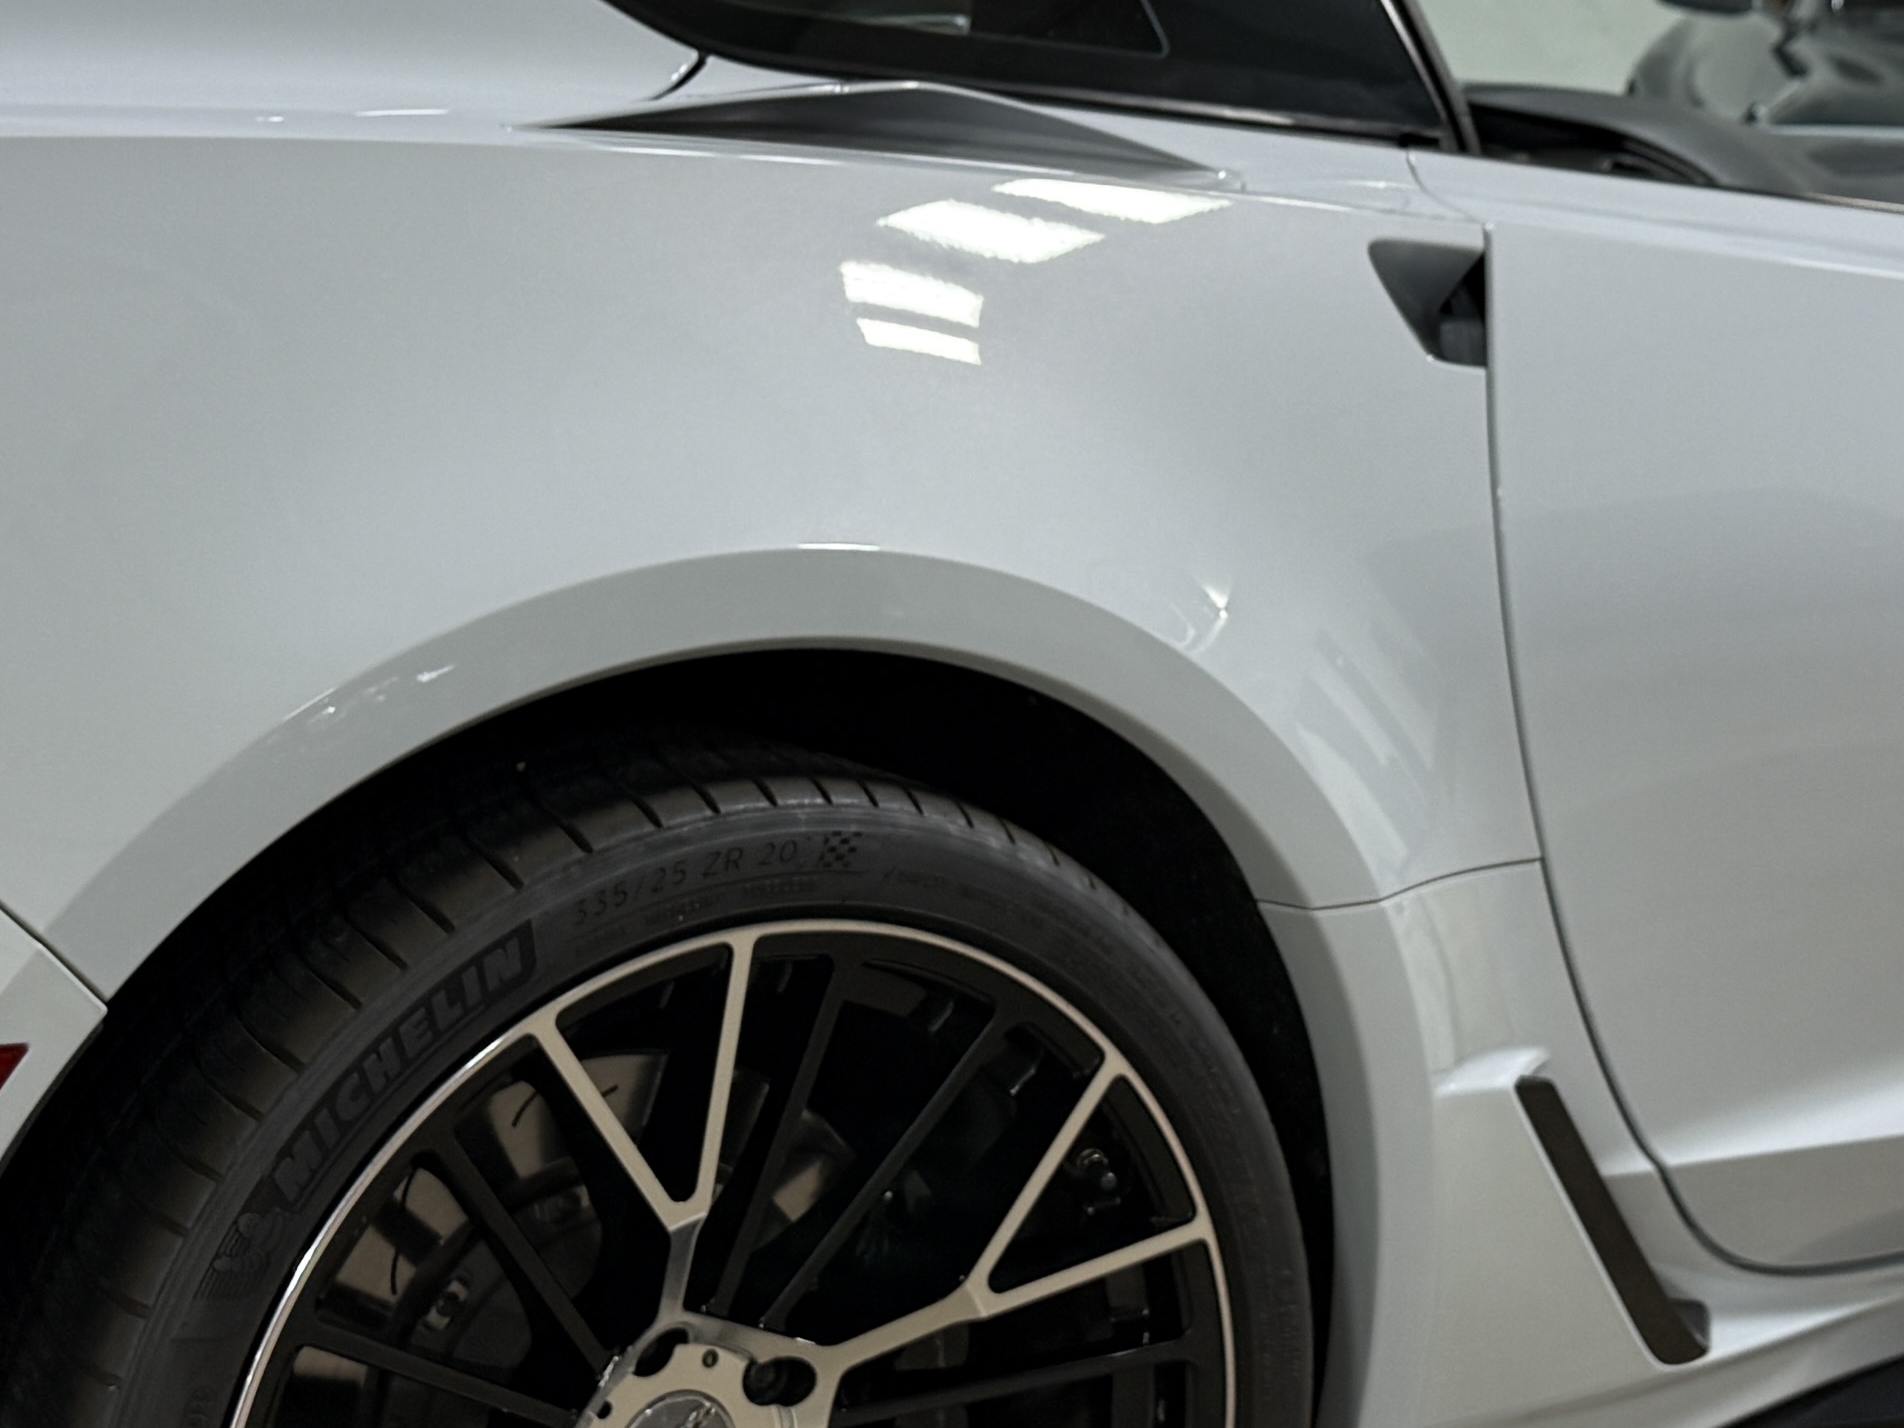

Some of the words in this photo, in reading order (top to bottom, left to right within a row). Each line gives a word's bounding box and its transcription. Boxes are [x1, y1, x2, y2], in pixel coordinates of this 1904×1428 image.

[573, 859, 688, 927] 335/25
[701, 846, 744, 880] ZR
[758, 839, 799, 867] 20
[279, 935, 527, 1207] MICHELIN
